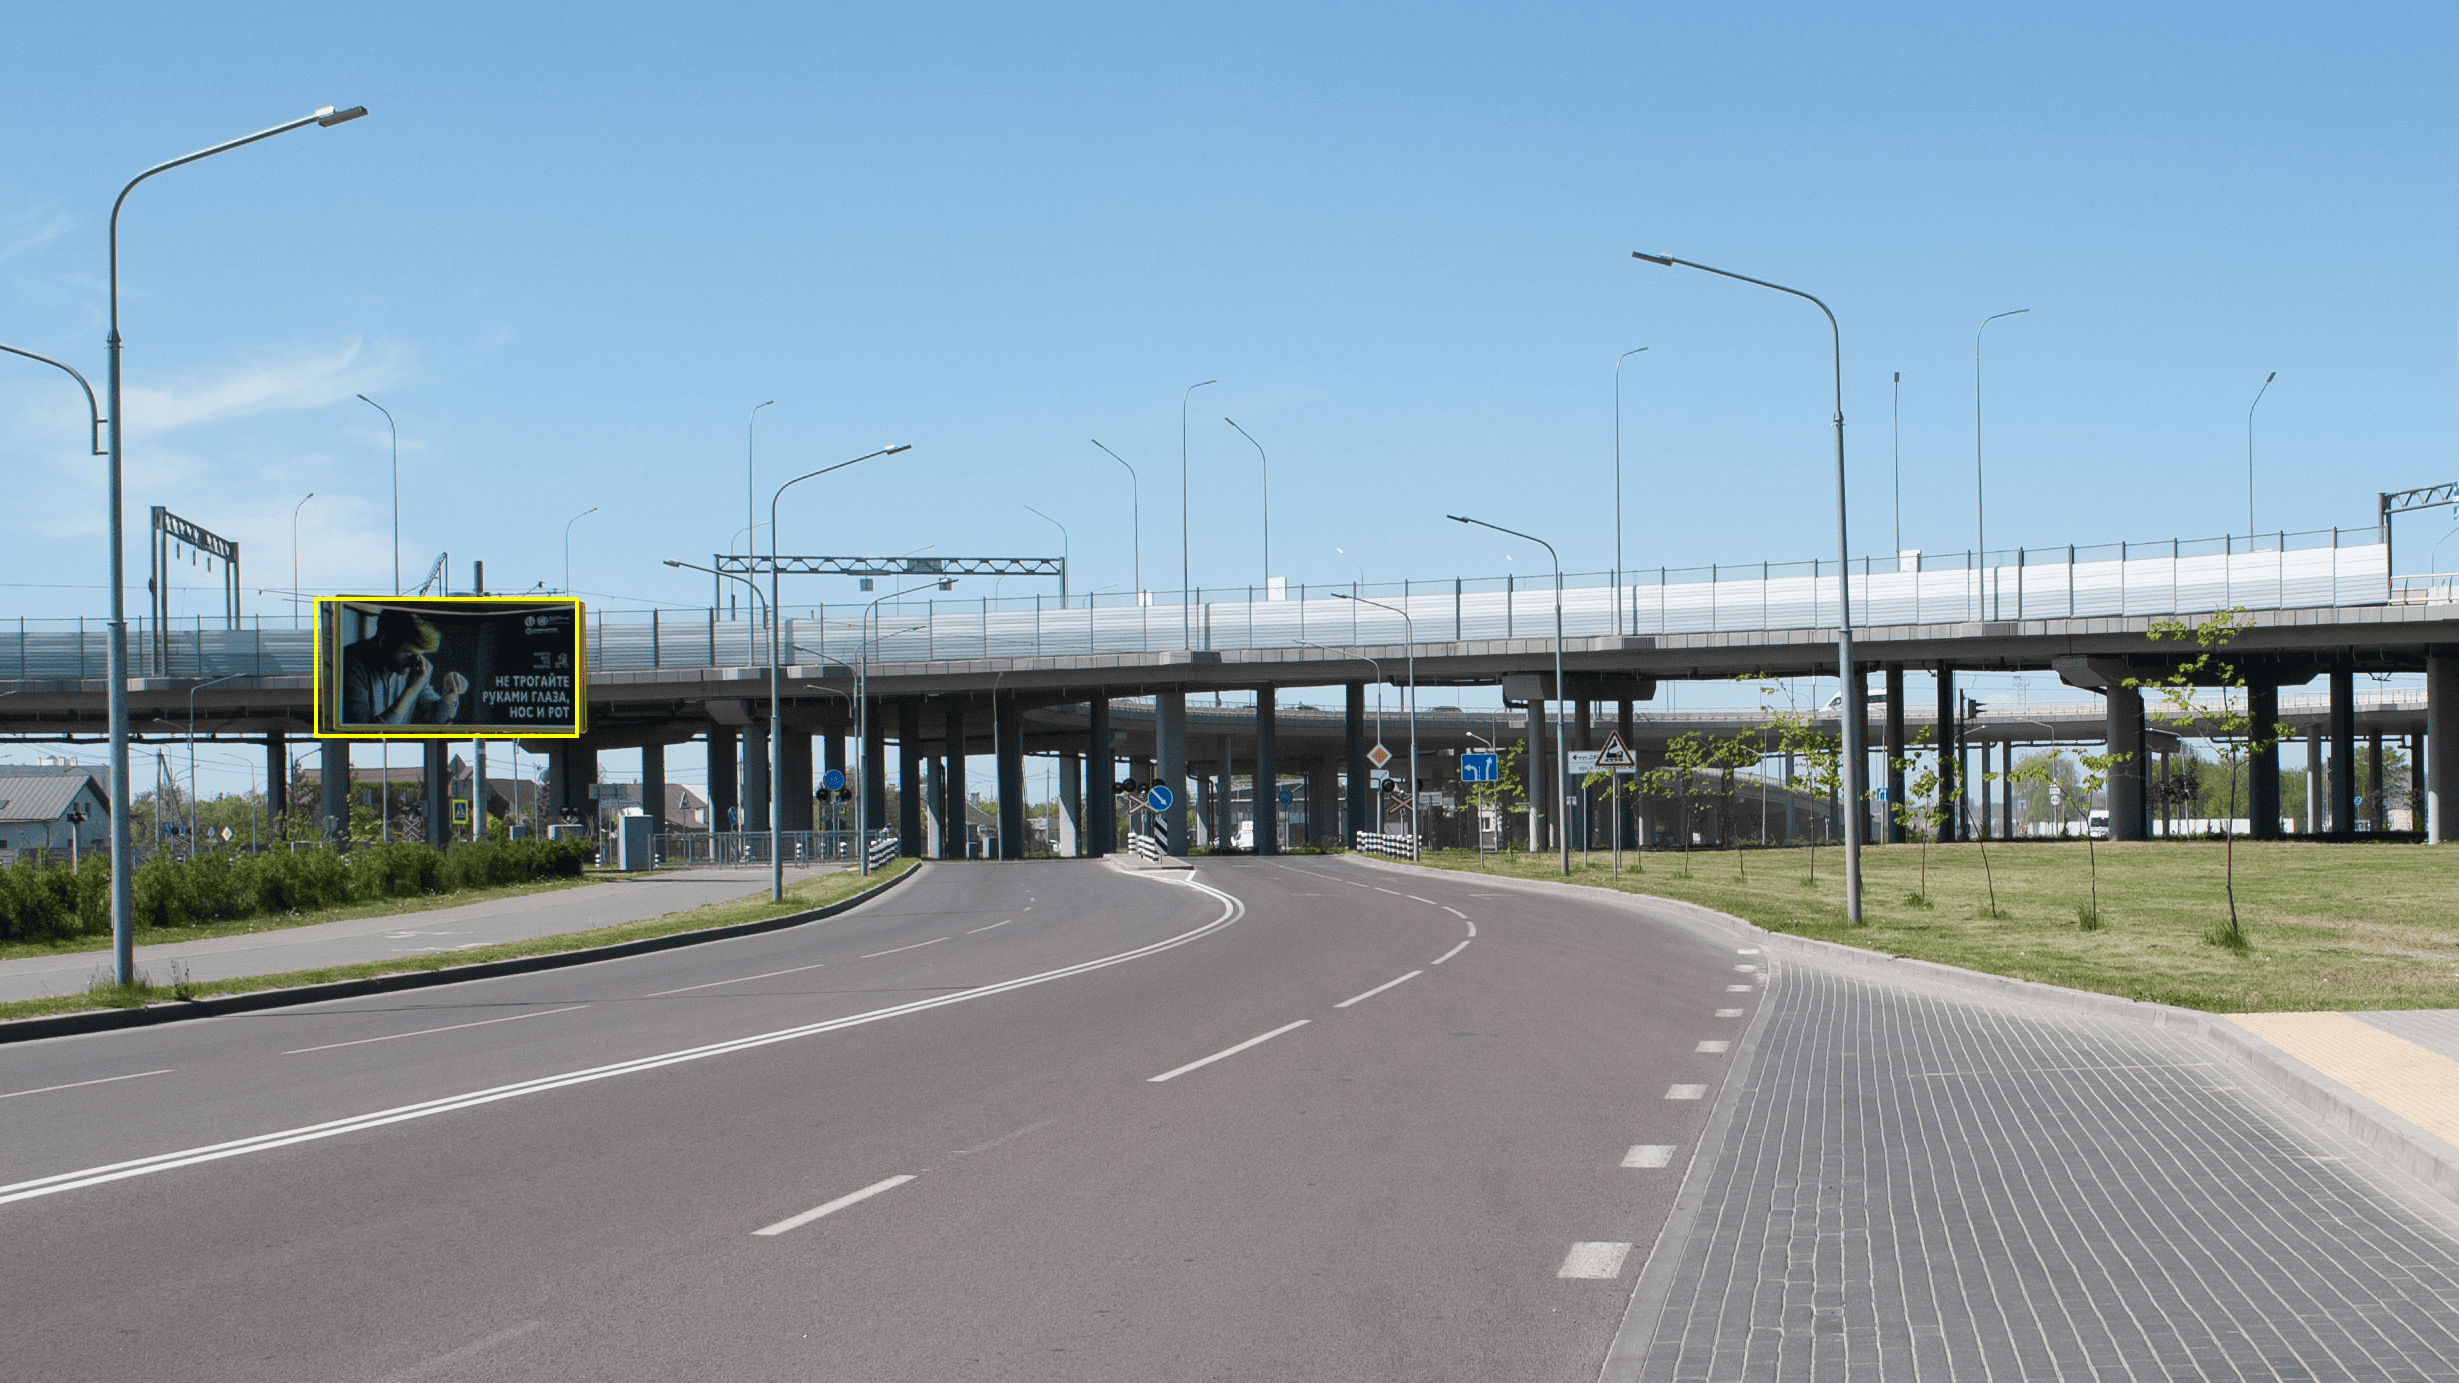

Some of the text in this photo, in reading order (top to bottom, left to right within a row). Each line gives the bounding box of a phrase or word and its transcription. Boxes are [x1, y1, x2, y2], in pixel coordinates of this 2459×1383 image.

[495, 673, 570, 687] НЕ ТРОГАЙТЕ
[482, 691, 570, 705] РУКАМИ ГЛАЗА,
[509, 706, 570, 718] НОС И РОТ
